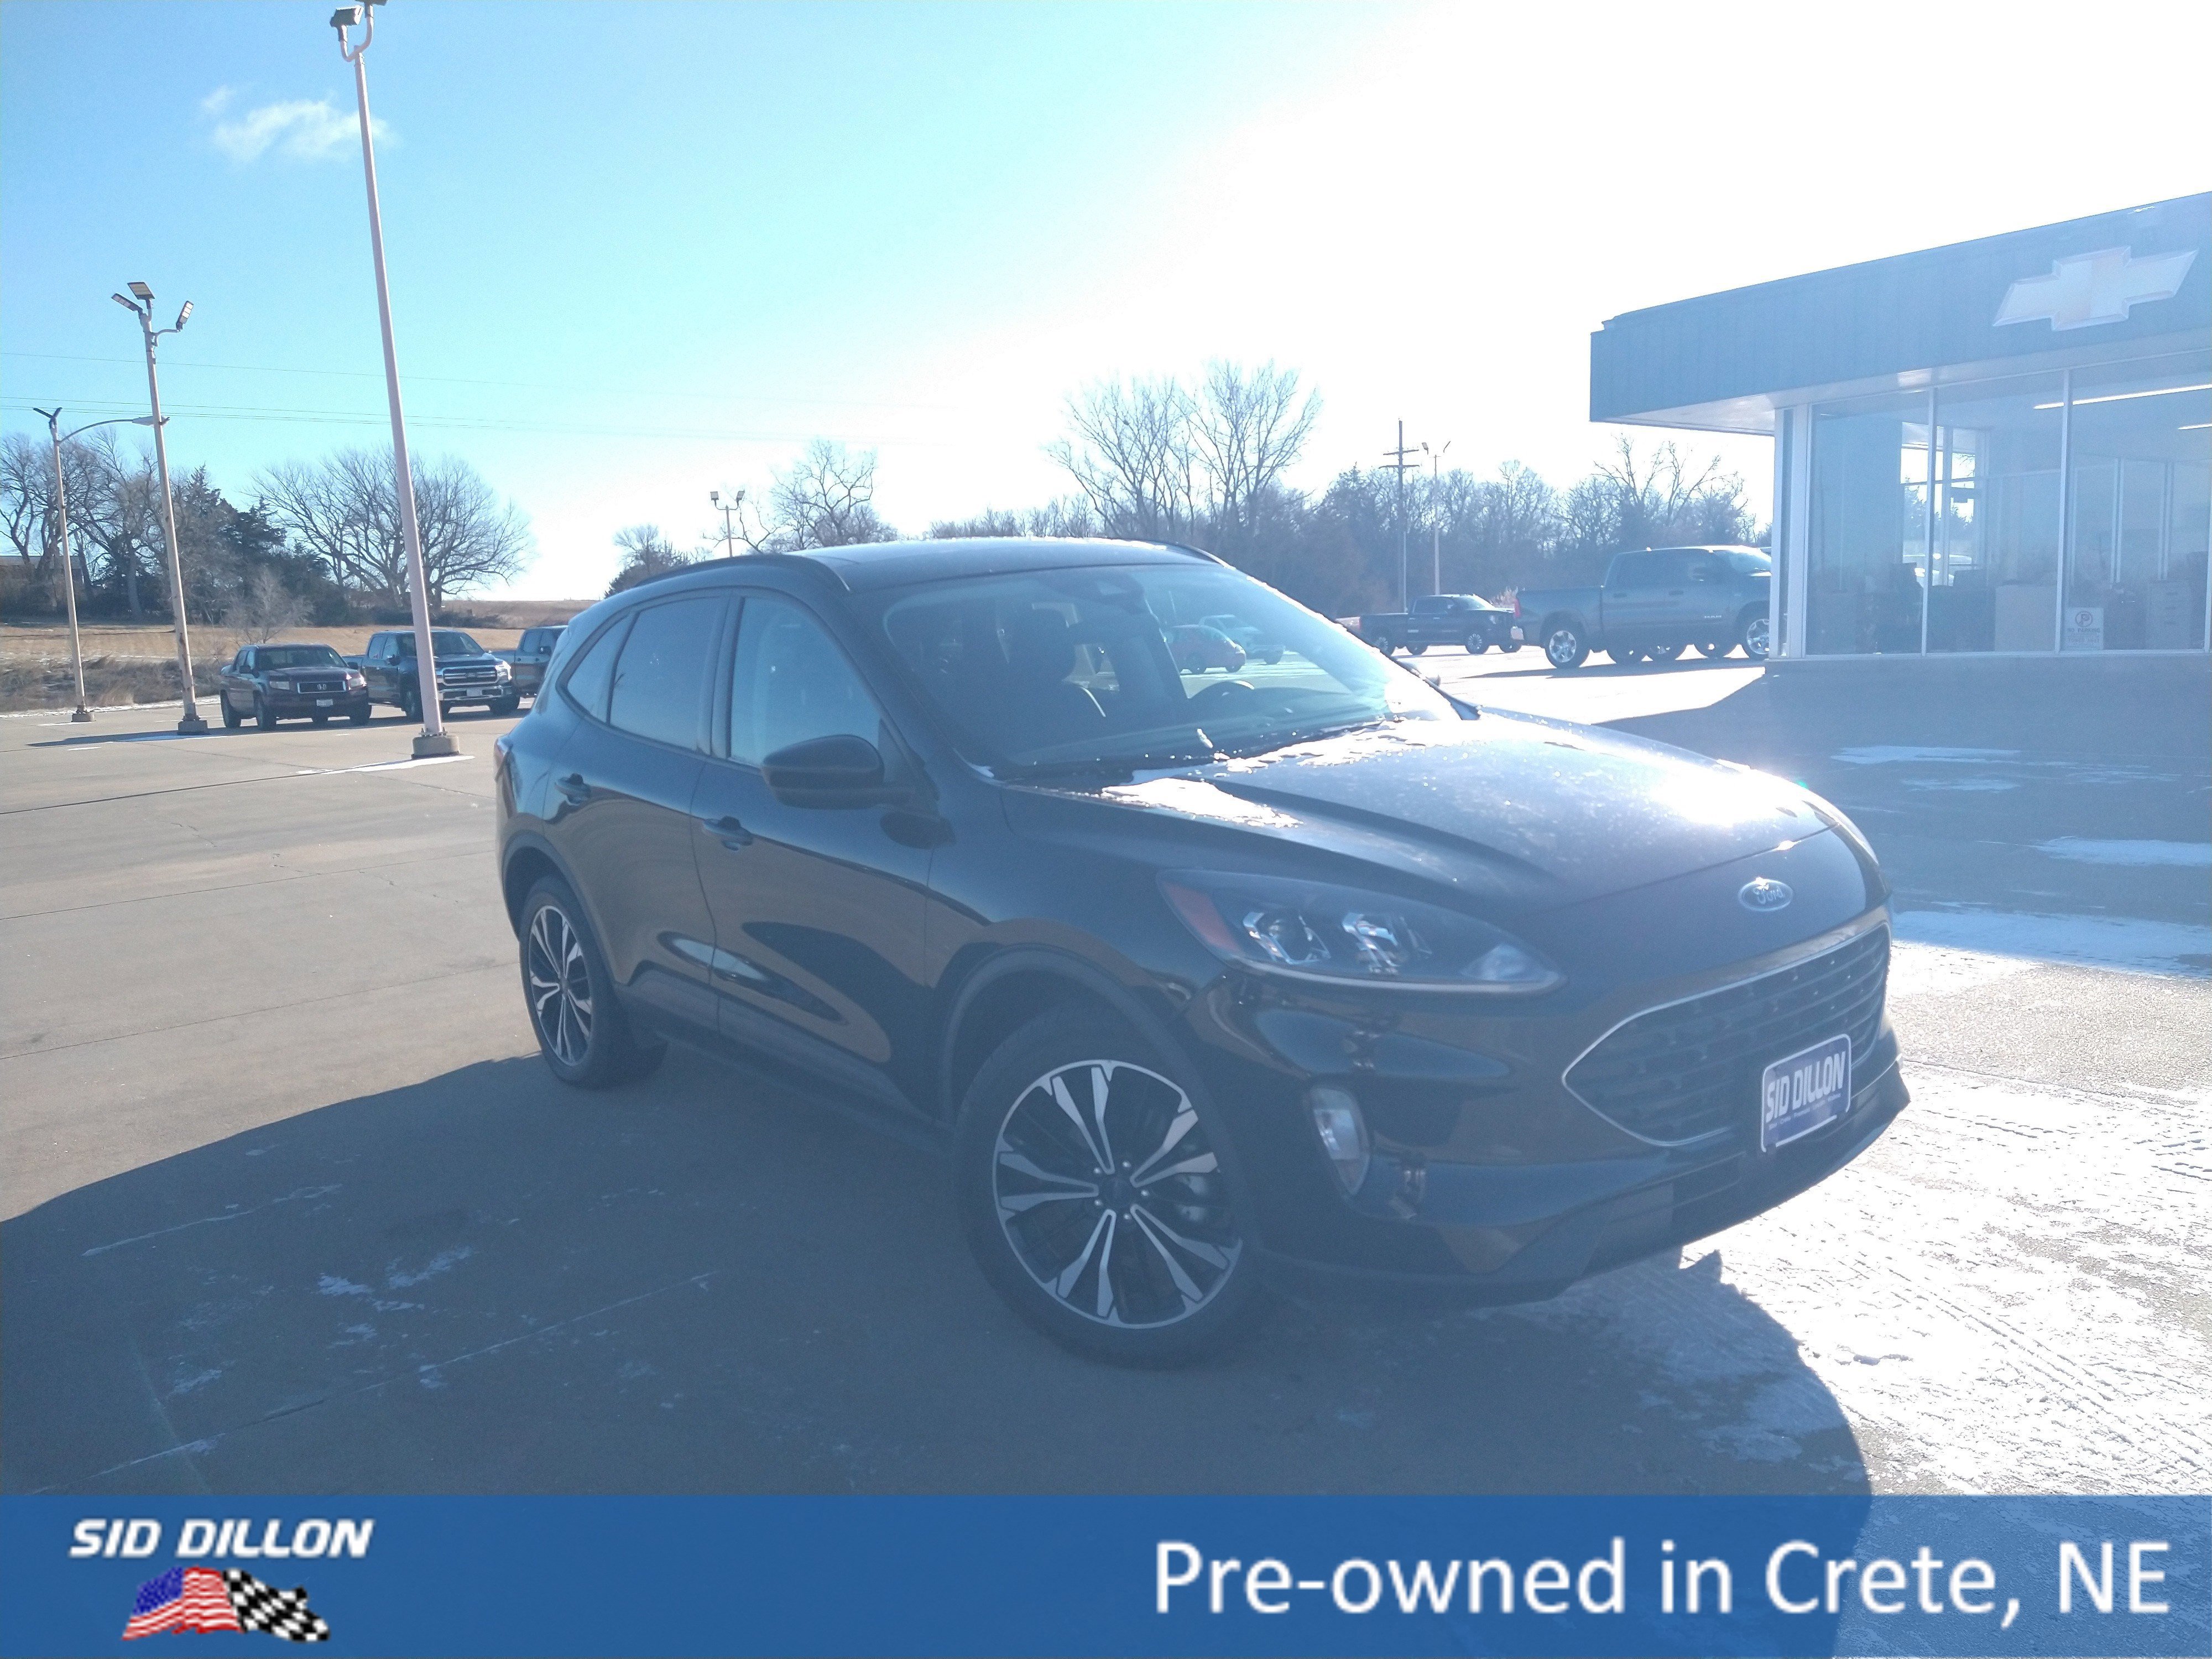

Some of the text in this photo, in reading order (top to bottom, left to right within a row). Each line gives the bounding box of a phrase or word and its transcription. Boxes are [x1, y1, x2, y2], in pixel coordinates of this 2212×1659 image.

[1753, 885, 1783, 904] Ford
[1766, 1051, 1846, 1123] SID DILLON
